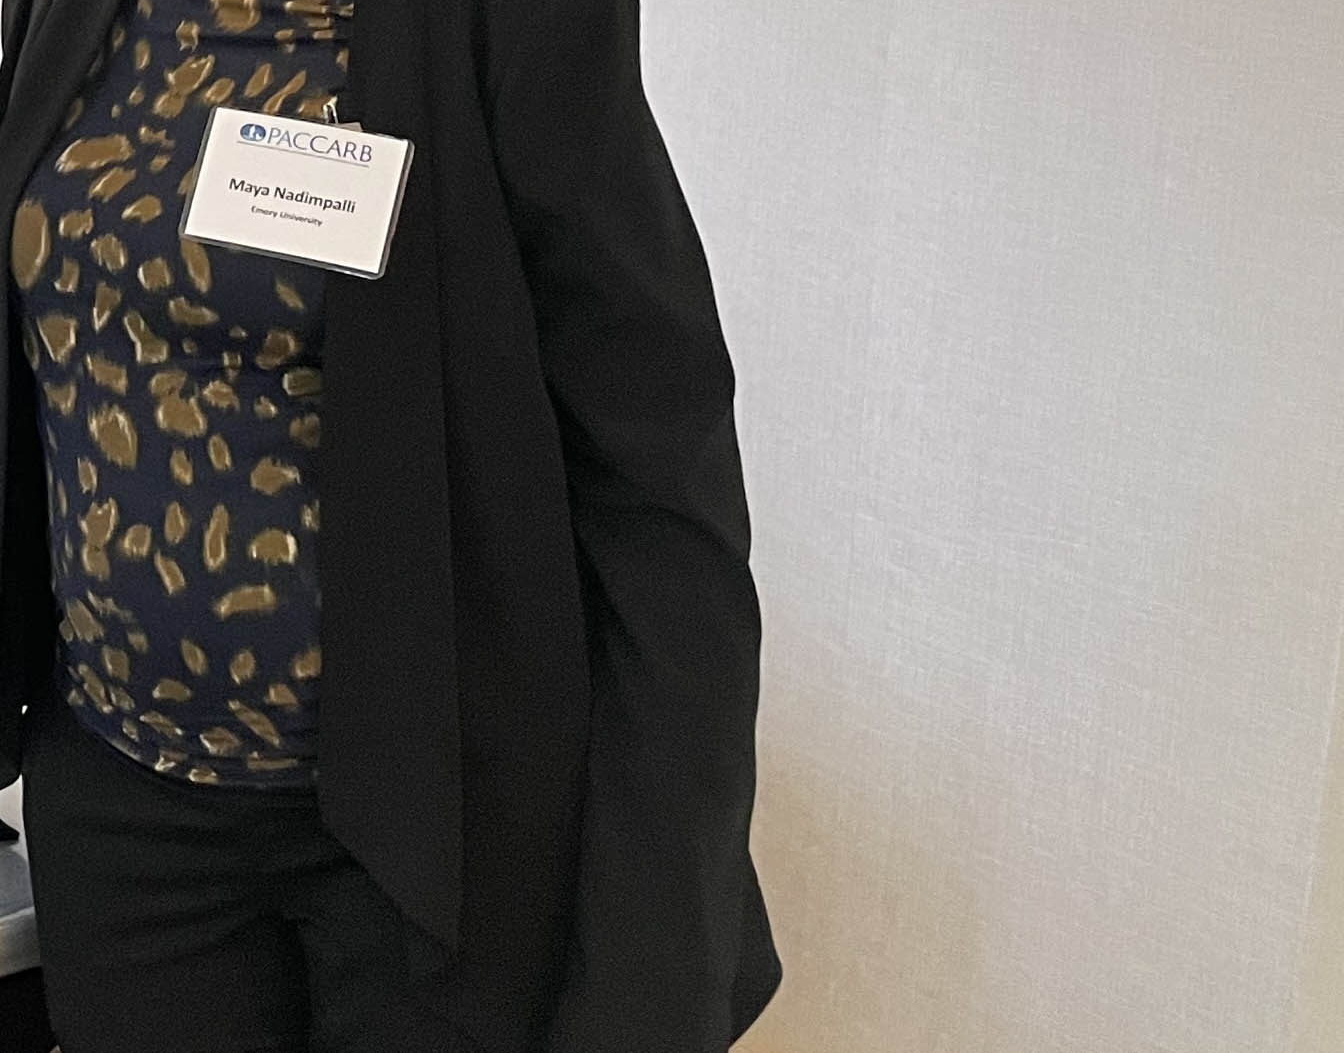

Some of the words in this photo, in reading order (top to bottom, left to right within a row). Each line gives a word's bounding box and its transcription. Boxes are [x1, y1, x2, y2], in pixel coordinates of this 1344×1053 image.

[266, 126, 373, 163] PACCARB
[228, 177, 270, 197] Maya
[273, 186, 356, 214] Nadimpalli
[251, 205, 278, 218] Emory
[279, 211, 323, 227] University
